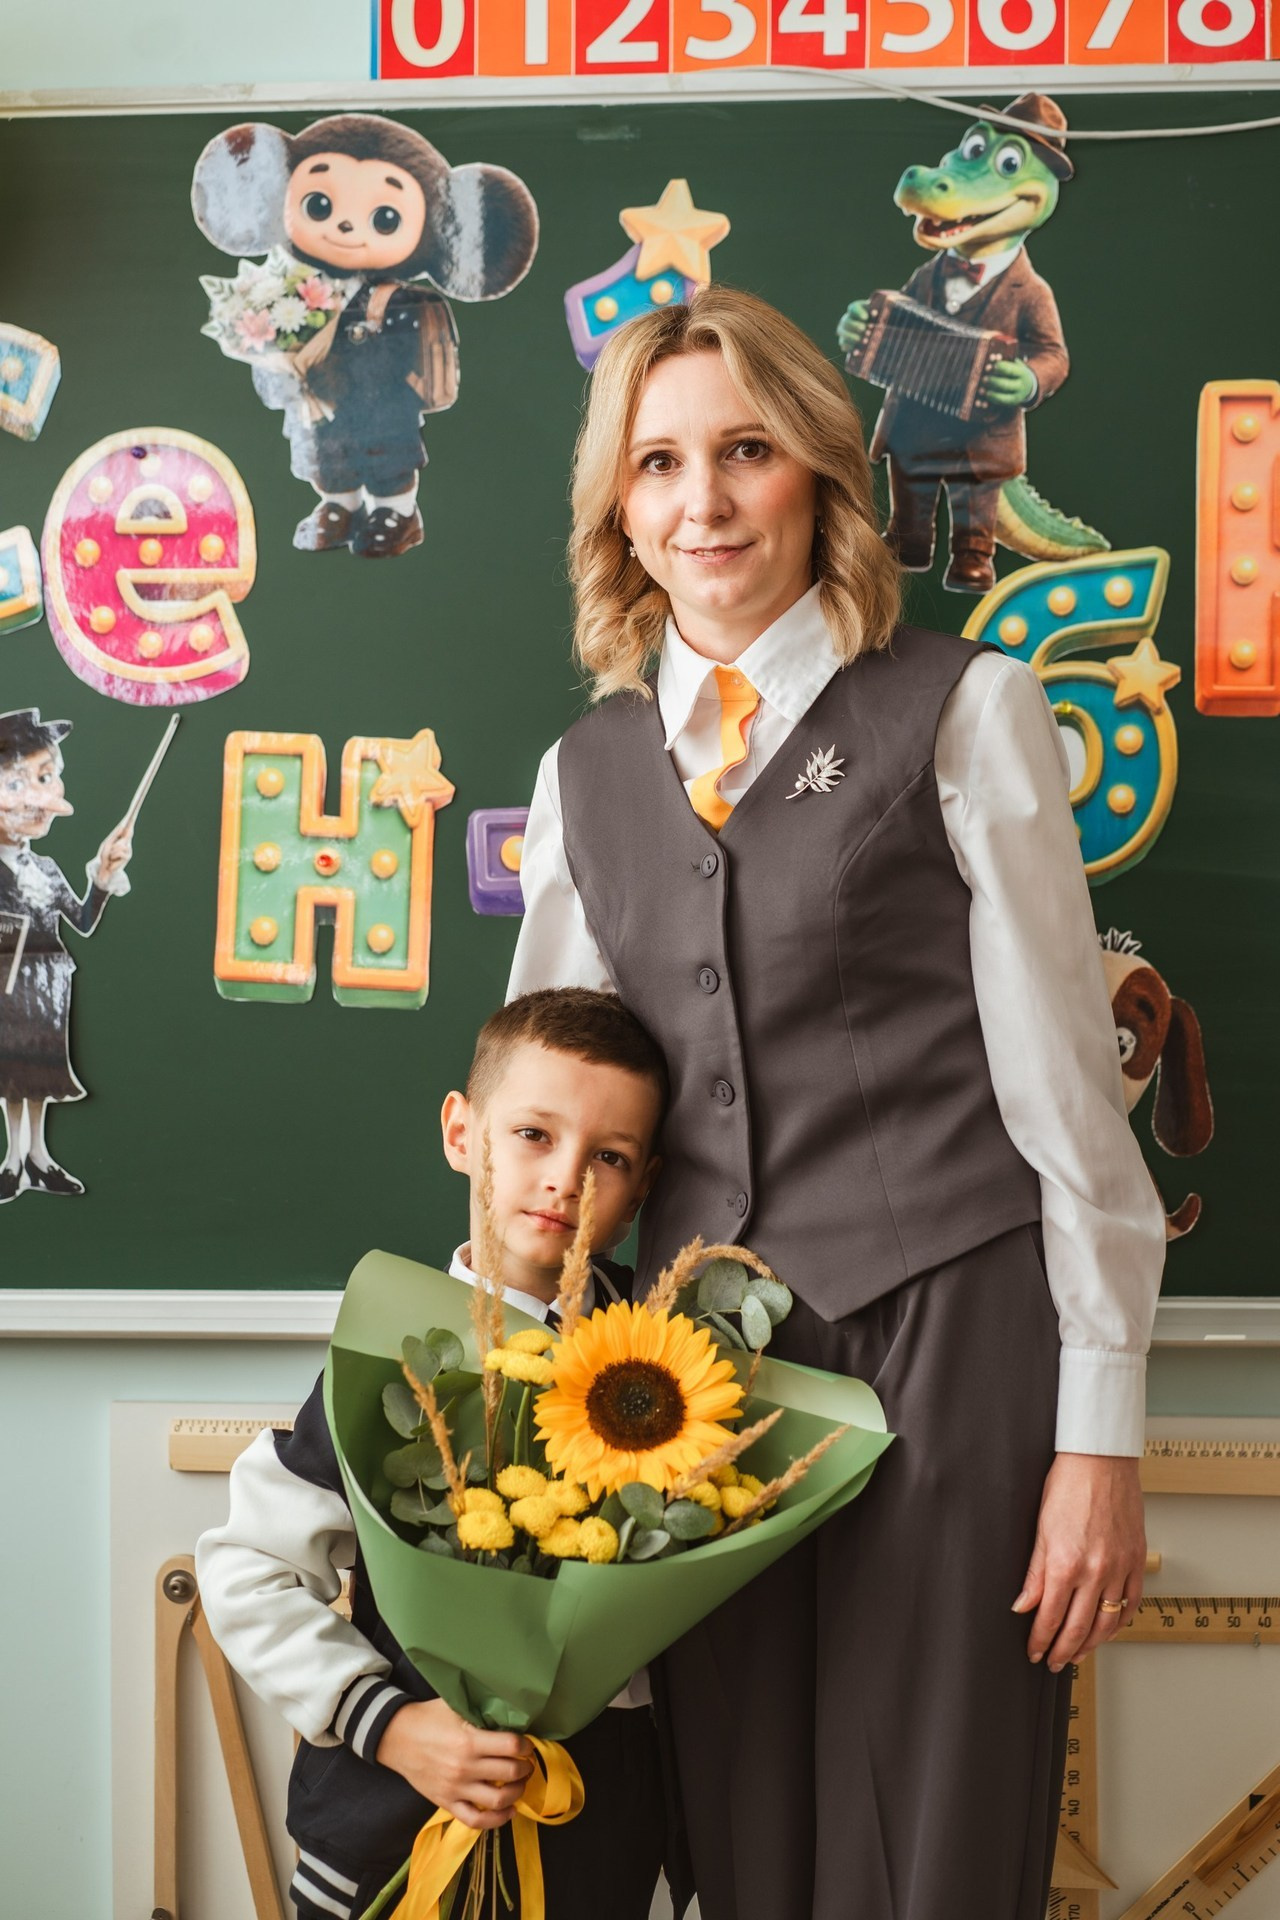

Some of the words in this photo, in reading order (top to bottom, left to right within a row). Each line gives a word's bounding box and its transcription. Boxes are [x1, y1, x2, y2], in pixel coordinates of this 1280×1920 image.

[391, 0, 465, 67] 0
[525, 0, 548, 65] 1
[586, 0, 659, 63] 2
[778, 0, 859, 56] 4
[1160, 1616, 1174, 1628] 70
[1195, 1616, 1209, 1628] 60
[1227, 1616, 1241, 1628] 50
[1258, 1616, 1272, 1628] 40
[1067, 1738, 1079, 1755] 120
[1067, 1769, 1080, 1786] 130
[1068, 1799, 1080, 1816] 140
[1182, 1901, 1196, 1913] 10
